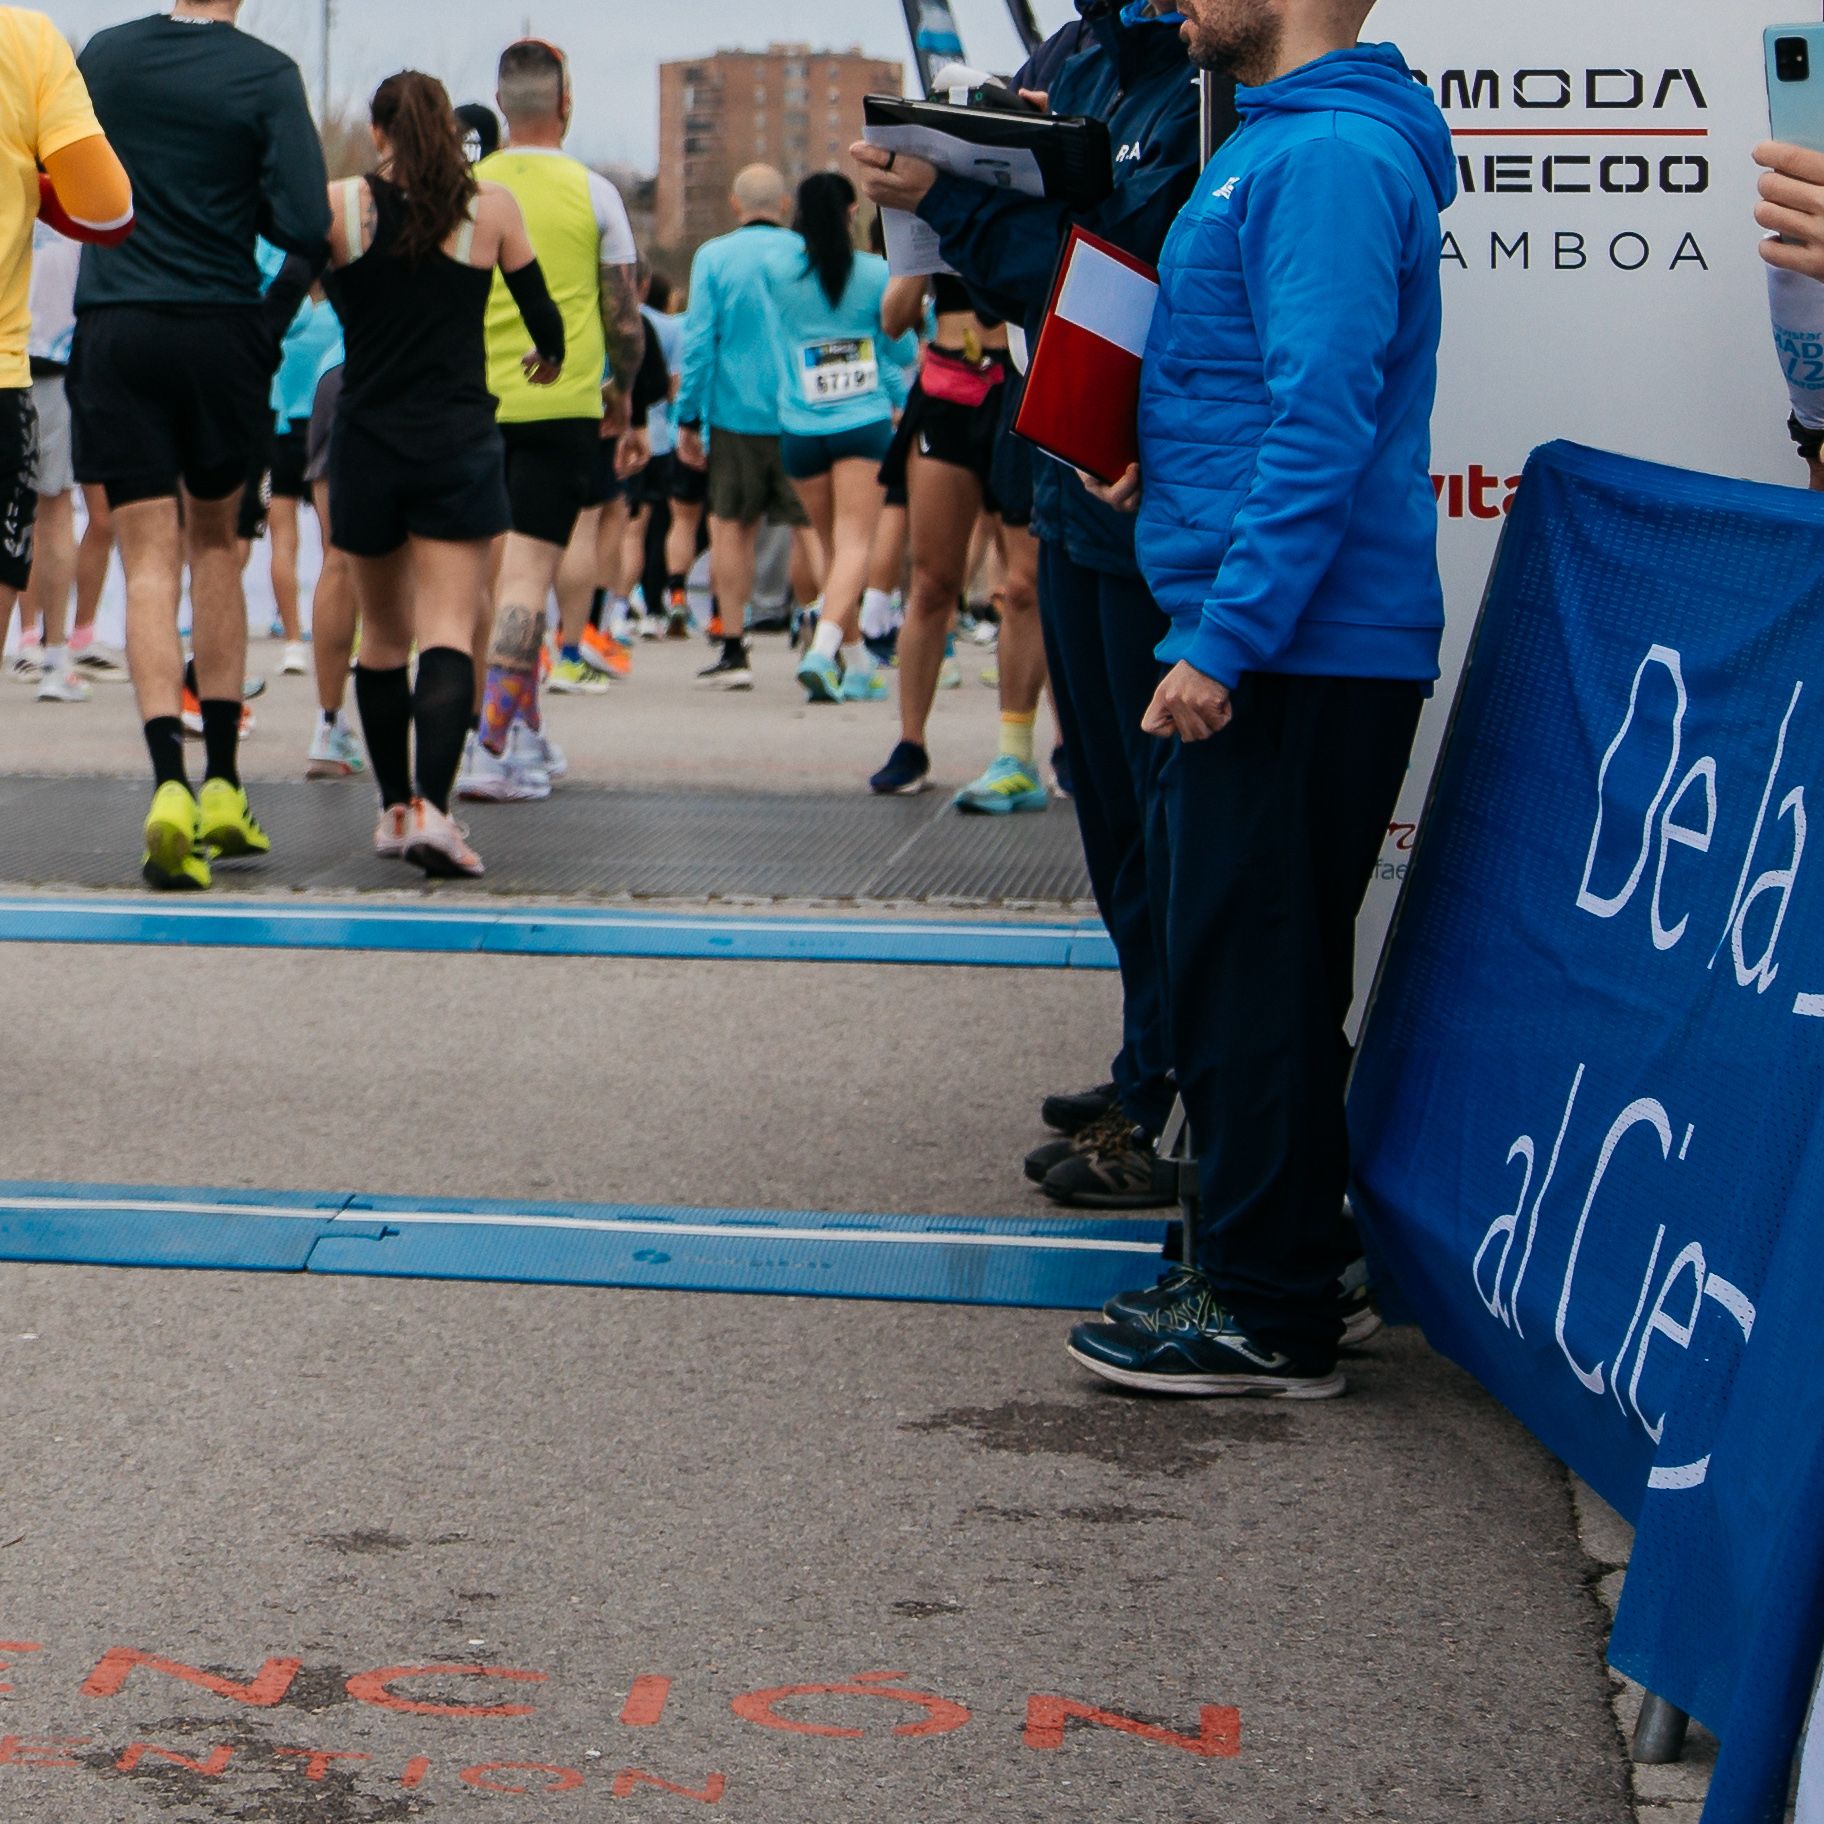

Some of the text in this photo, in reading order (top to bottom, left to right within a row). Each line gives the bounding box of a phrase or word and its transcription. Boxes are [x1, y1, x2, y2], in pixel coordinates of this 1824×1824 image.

[1409, 68, 1709, 109] MODA
[1457, 155, 1709, 193] ECOO
[1575, 643, 1717, 950] De
[1473, 1062, 1585, 1340] al
